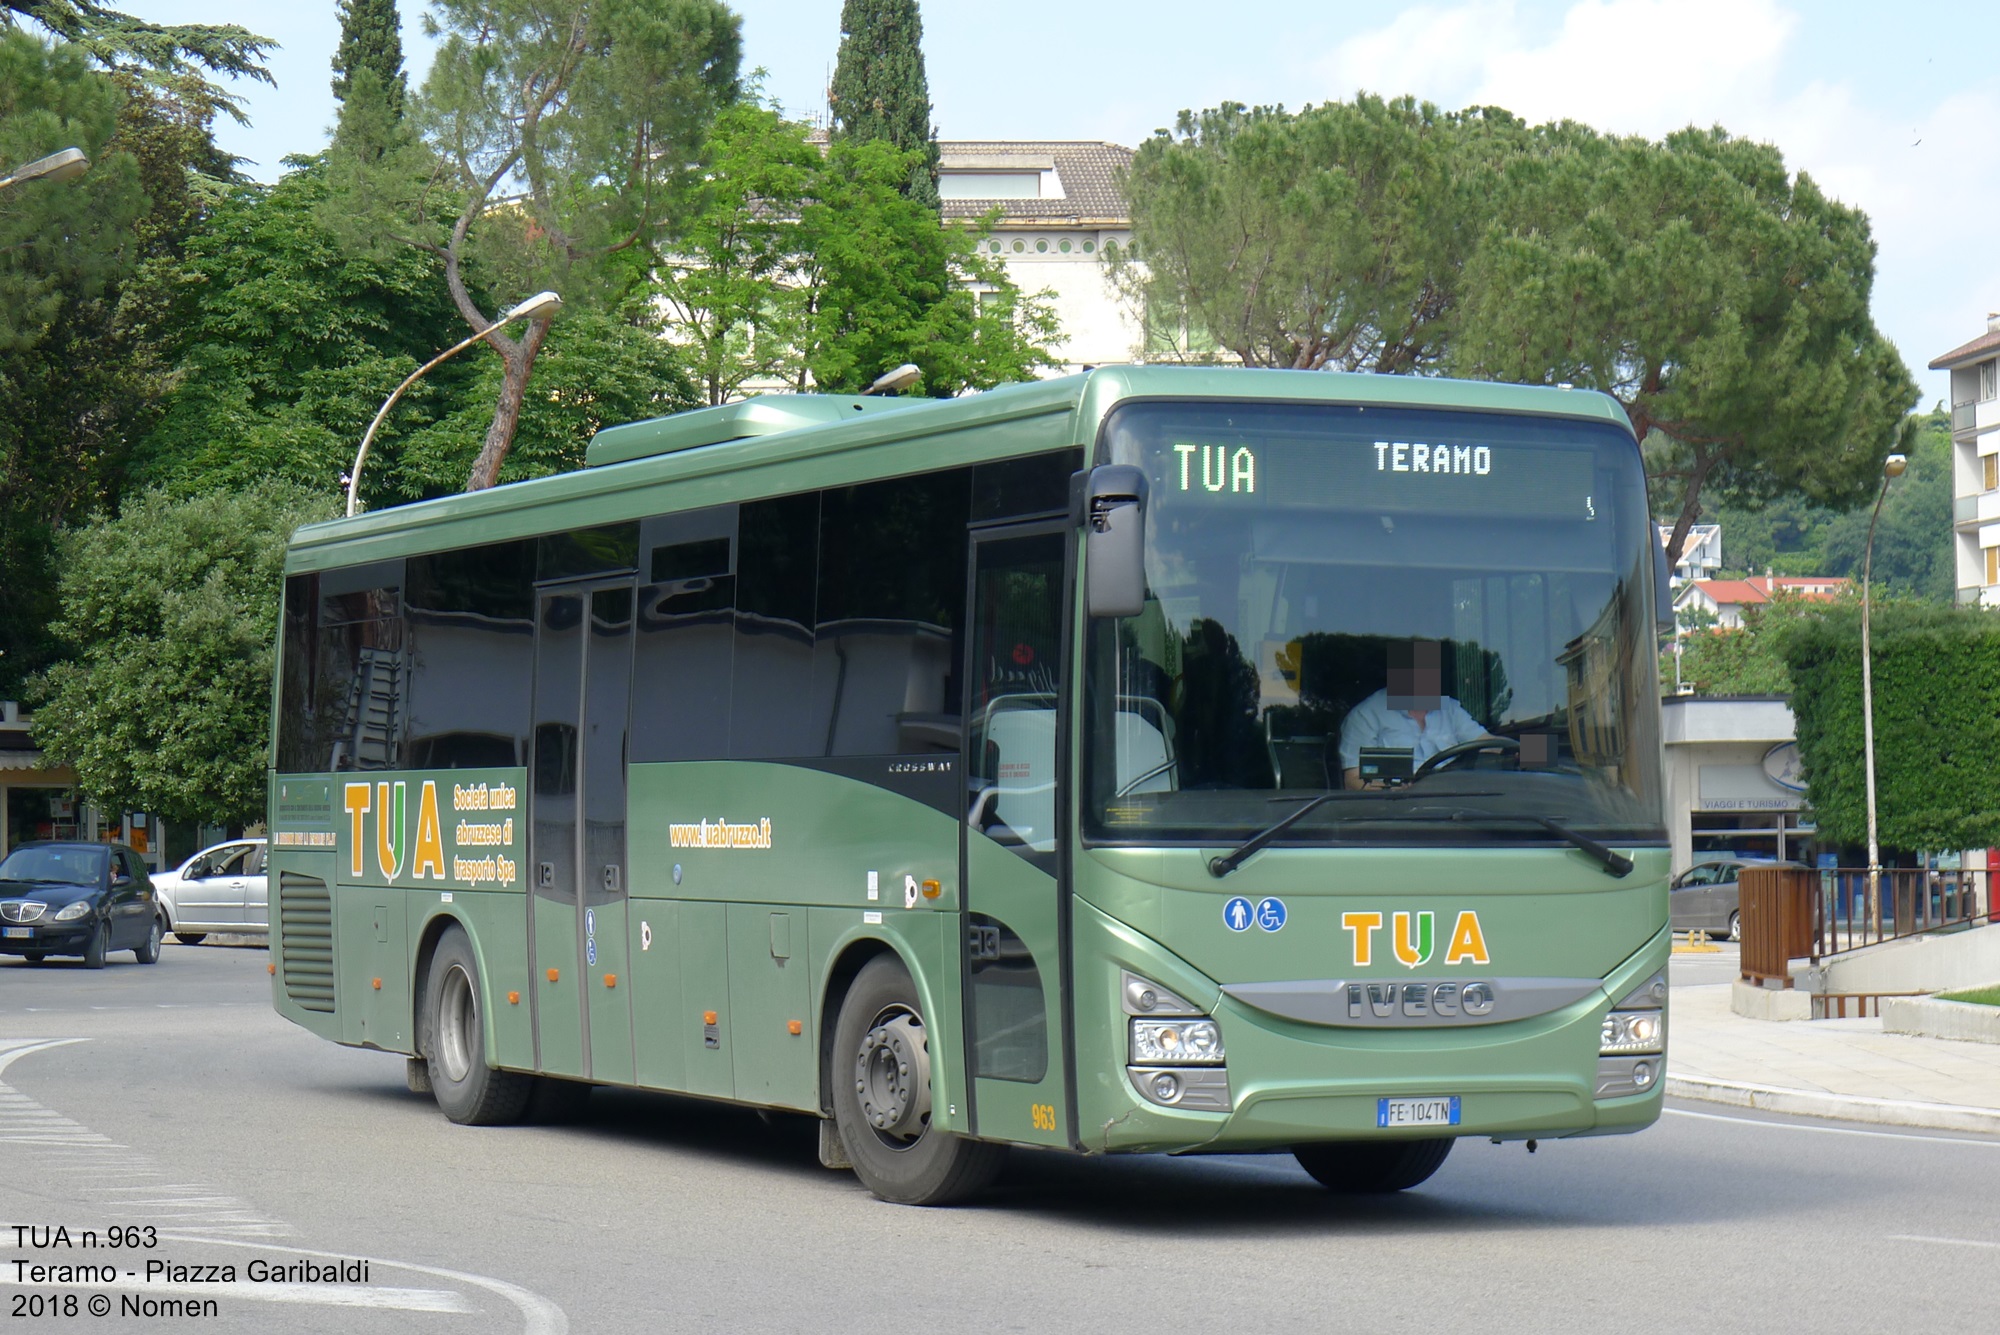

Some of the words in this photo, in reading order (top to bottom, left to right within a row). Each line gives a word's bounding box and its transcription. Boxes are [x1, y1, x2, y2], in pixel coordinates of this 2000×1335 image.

[1173, 444, 1255, 493] TUA
[1373, 441, 1491, 475] TERAMO
[888, 761, 953, 773] CROSSWAY
[454, 782, 488, 811] Società
[489, 782, 516, 810] unica
[1704, 799, 1737, 809] VIAGGI
[1738, 799, 1745, 808] E
[1747, 799, 1789, 808] TURISMO
[345, 780, 446, 885] TUA
[456, 818, 502, 846] abruzzese
[503, 817, 513, 846] di
[454, 854, 497, 887] trasporto
[497, 854, 516, 888] Spa
[1341, 910, 1490, 969] TUA
[1347, 981, 1495, 1018] IVECO
[1031, 1103, 1056, 1131] 963
